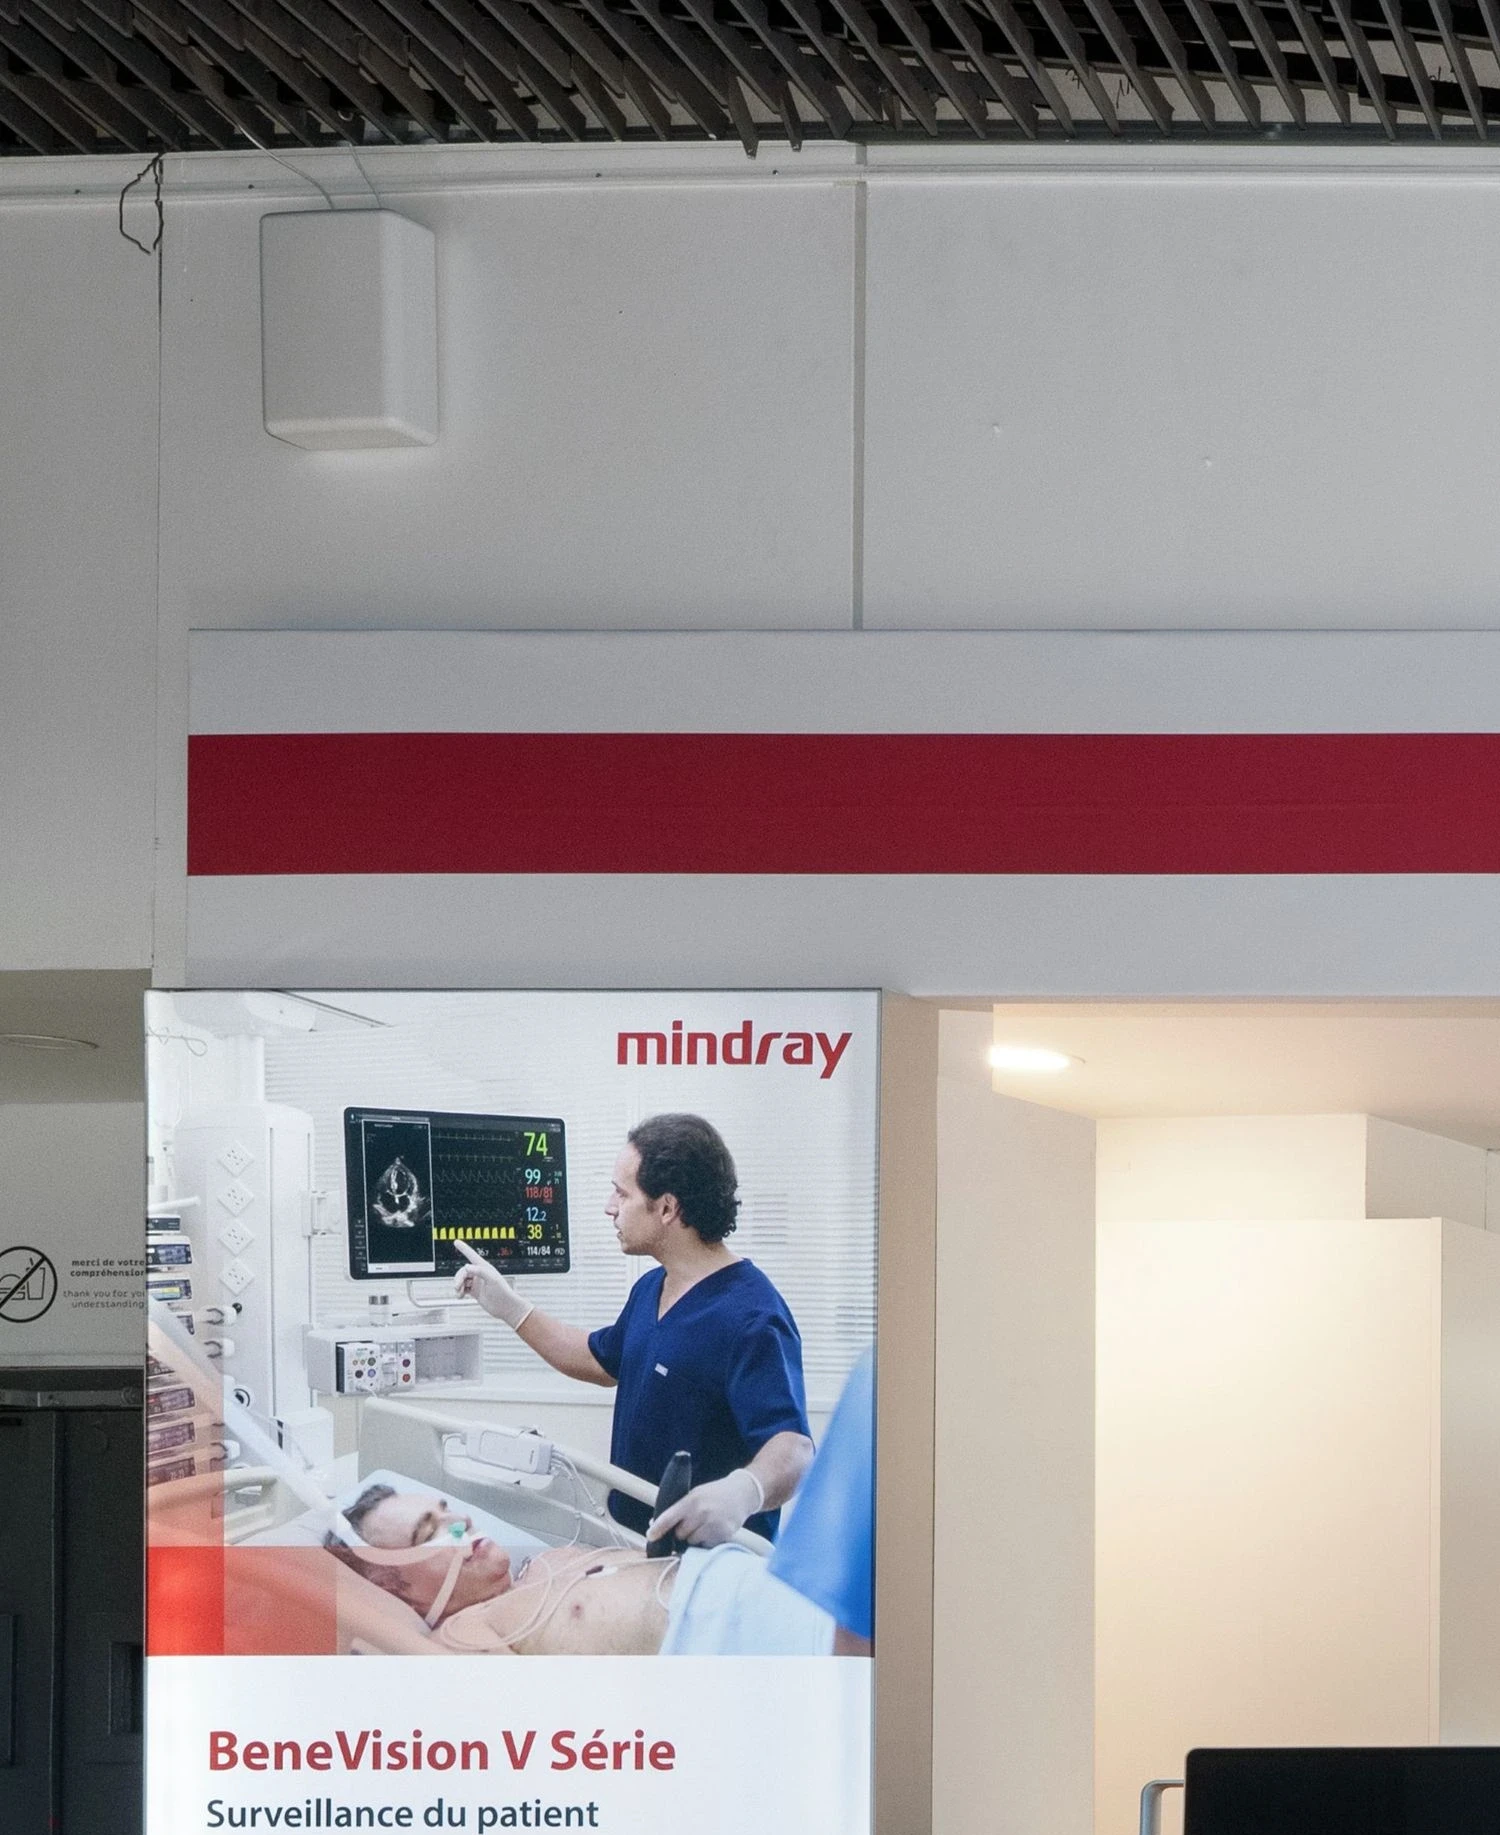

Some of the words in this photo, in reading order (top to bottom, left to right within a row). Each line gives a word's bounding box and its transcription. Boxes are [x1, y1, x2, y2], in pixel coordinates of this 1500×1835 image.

[618, 1020, 852, 1079] mindray
[523, 1132, 548, 1156] 74
[525, 1169, 541, 1185] 99
[528, 1225, 542, 1239] 38
[72, 1259, 101, 1267] merci
[102, 1259, 115, 1267] de
[71, 1301, 145, 1309] understanding
[210, 1729, 488, 1770] BeneVision
[502, 1731, 536, 1770] V
[551, 1729, 675, 1770] Série
[207, 1798, 413, 1827] Surveillance
[424, 1798, 465, 1827] du
[479, 1799, 598, 1834] patient
